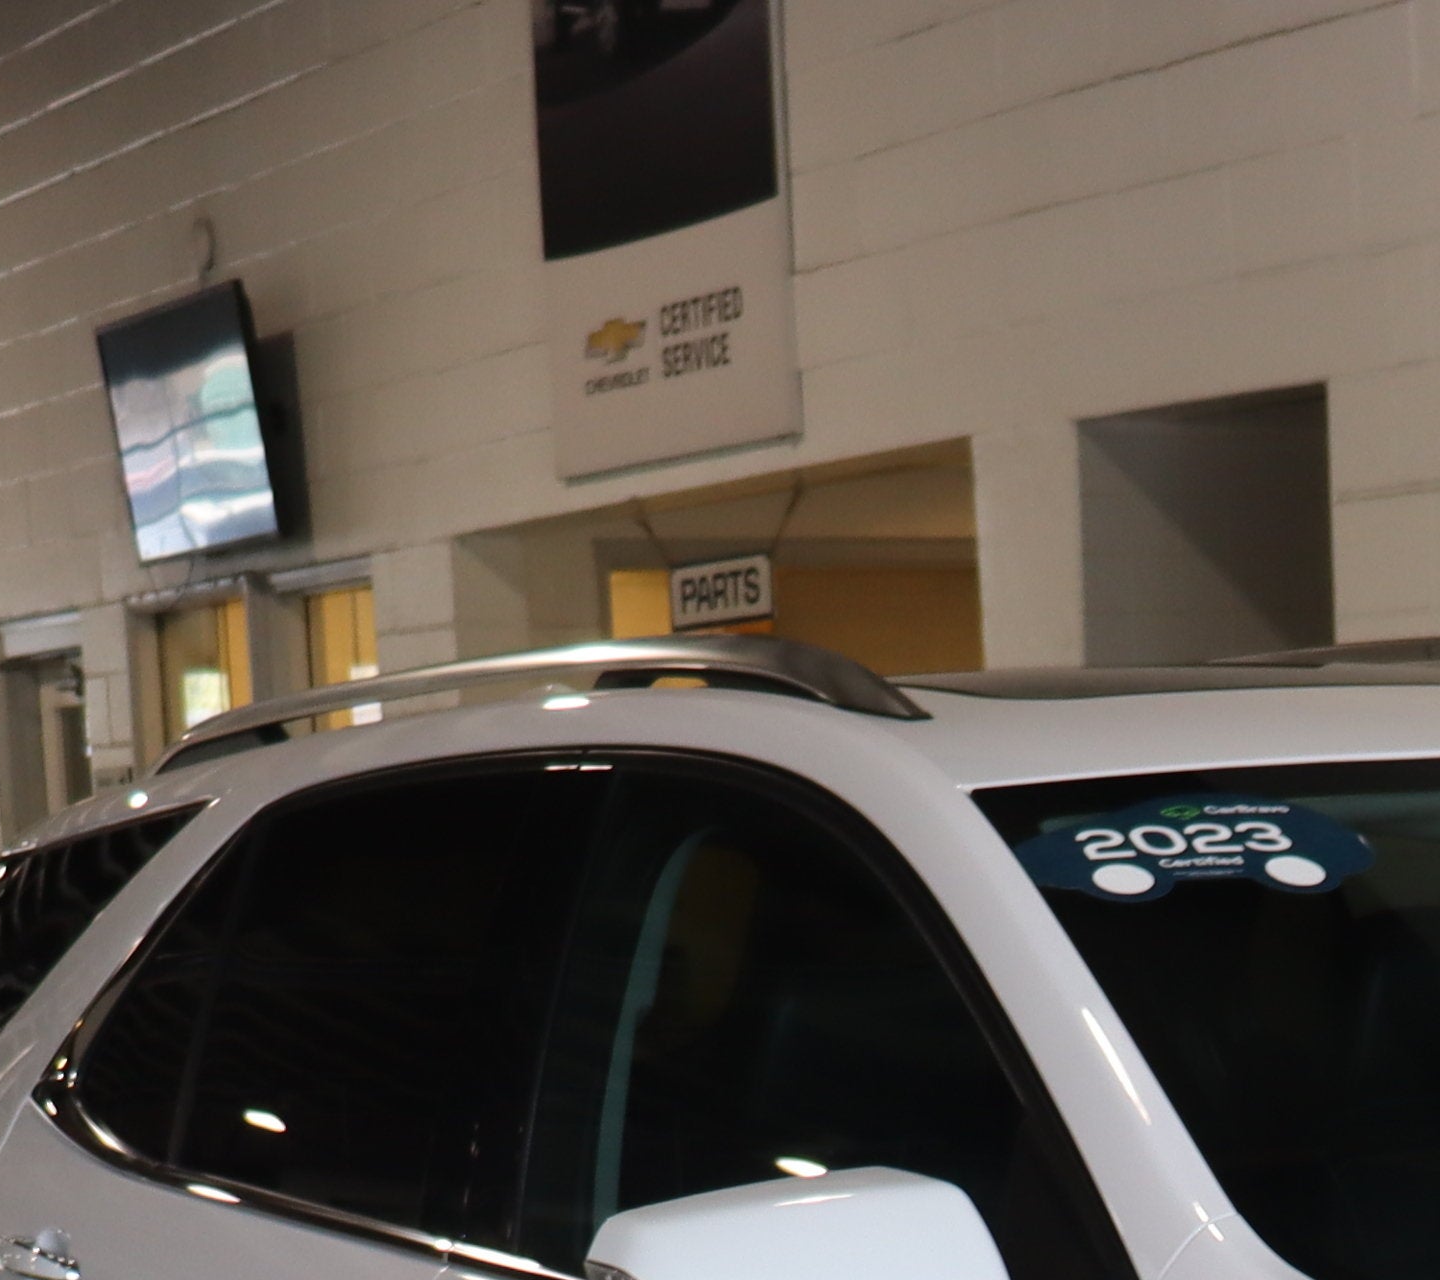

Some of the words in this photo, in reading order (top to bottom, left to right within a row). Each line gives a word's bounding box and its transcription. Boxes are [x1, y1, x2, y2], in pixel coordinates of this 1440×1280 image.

[658, 285, 745, 336] CERTIFIED
[660, 333, 732, 379] SERVICE
[584, 367, 651, 396] CHEVROLET
[680, 566, 761, 615] PARTS
[1074, 821, 1294, 862] 2023
[1157, 855, 1245, 869] Certified
